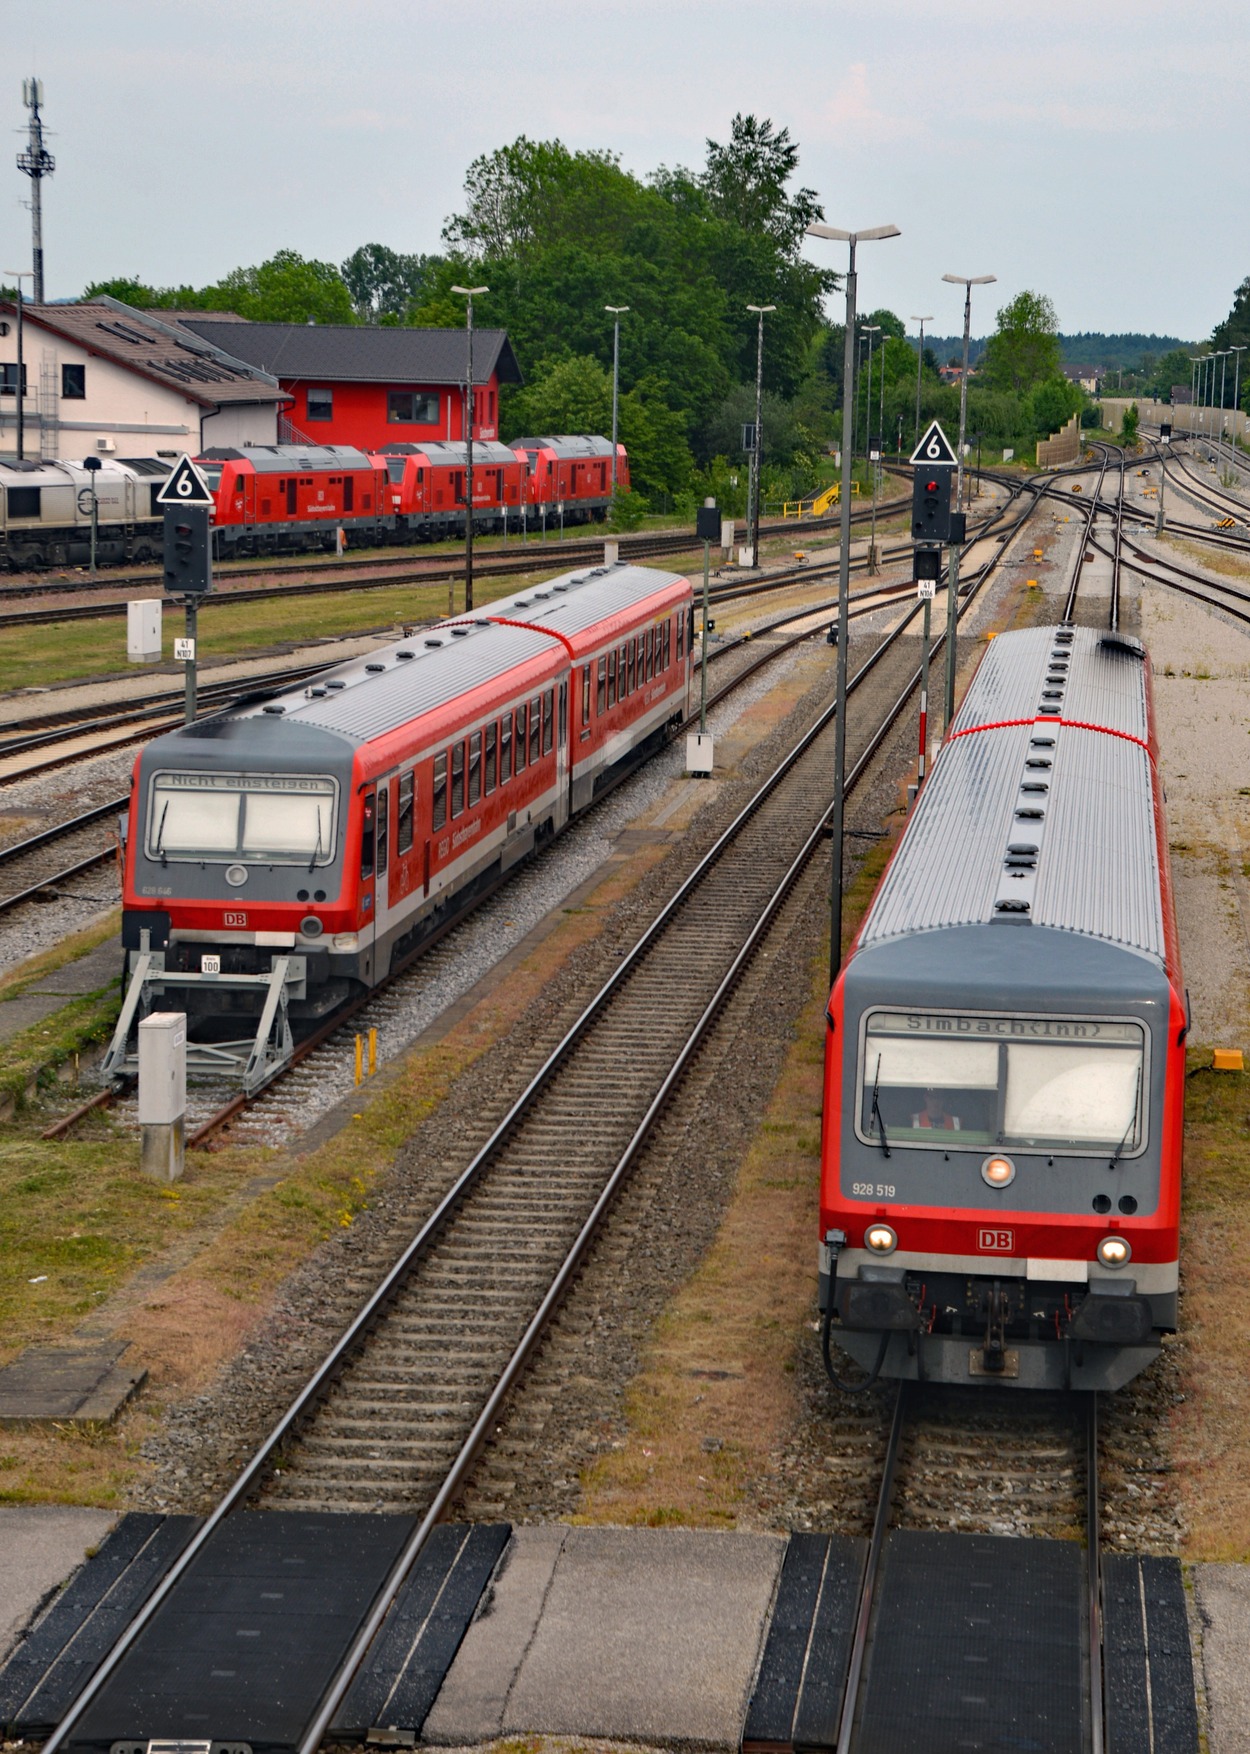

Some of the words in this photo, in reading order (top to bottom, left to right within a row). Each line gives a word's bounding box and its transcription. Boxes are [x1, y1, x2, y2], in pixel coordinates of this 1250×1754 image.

[926, 435, 941, 459] 6
[176, 469, 193, 497] 6
[172, 775, 216, 787] Nicht
[226, 777, 319, 790] einsteigen
[226, 913, 246, 926] DB
[203, 961, 219, 973] 100
[852, 1182, 874, 1196] 928
[876, 1183, 896, 1197] 519
[980, 1231, 1011, 1249] DB
